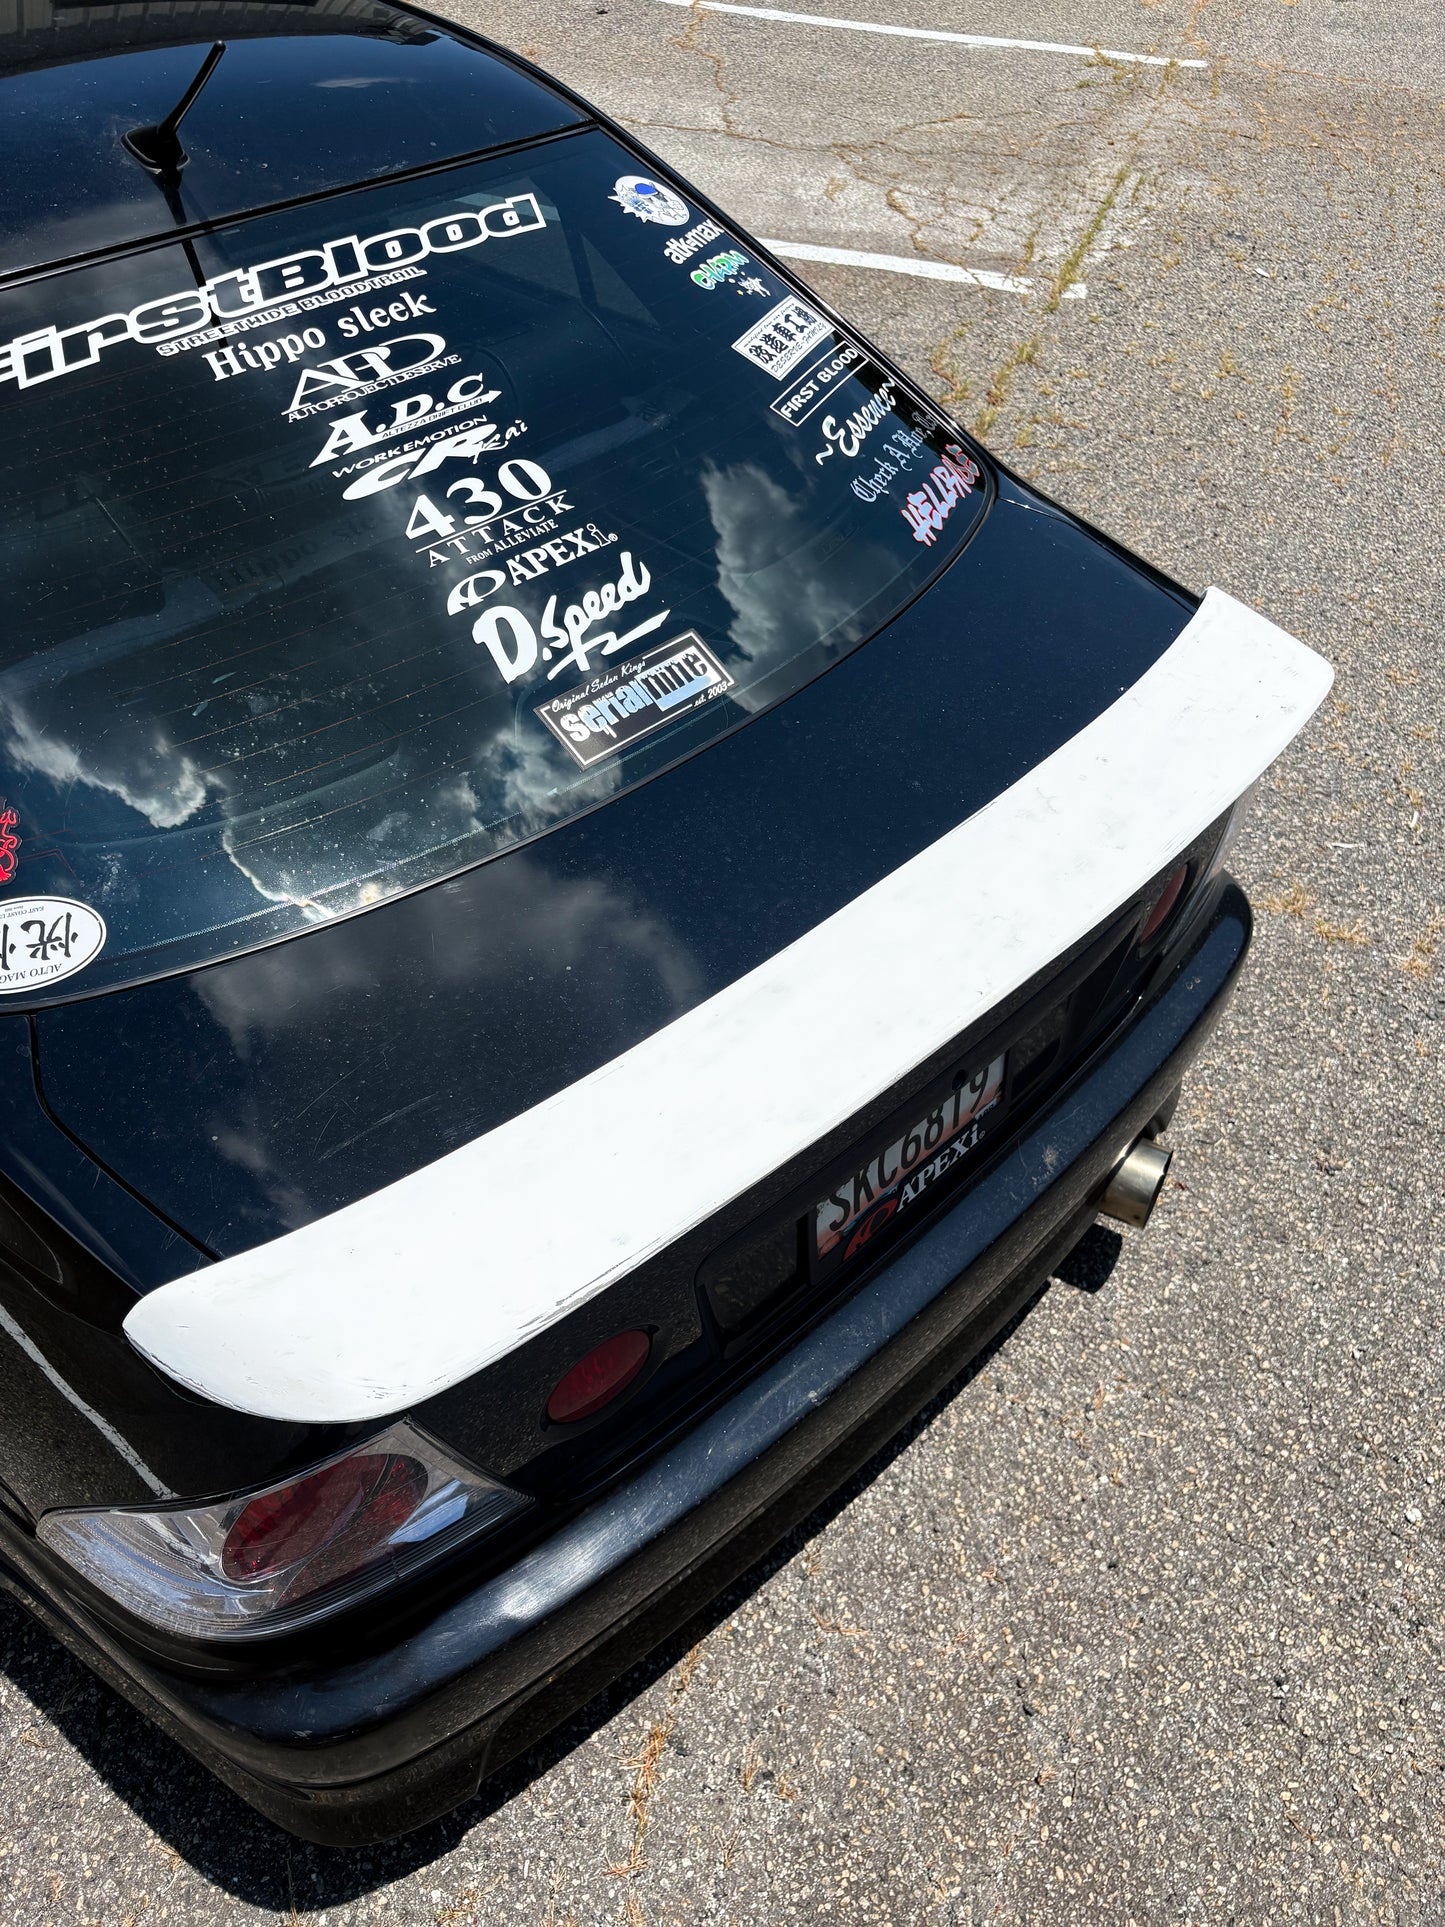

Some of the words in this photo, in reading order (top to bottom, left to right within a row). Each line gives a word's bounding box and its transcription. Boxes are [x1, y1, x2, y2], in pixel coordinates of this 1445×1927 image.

[156, 302, 301, 358] STREETWIDE
[297, 265, 427, 313] BLOODTRAIL
[201, 327, 327, 382] Hippo
[340, 292, 437, 340] sleek
[780, 379, 818, 420] FIRST
[817, 348, 859, 385] BLOOD
[308, 373, 485, 468] A.D.C
[331, 446, 405, 479] WORK
[402, 414, 489, 455] EMOTION
[381, 418, 428, 439] ALTEZZA
[427, 406, 457, 425] DRIFT
[405, 458, 553, 541] 430
[850, 457, 898, 503] Check
[883, 444, 913, 472] A
[428, 494, 576, 568] ATTACK
[465, 546, 493, 566] FROM
[493, 518, 559, 554] ALLEVIATE
[551, 688, 590, 714] Original
[590, 673, 620, 695] Sedan
[620, 657, 647, 681] Kings
[692, 693, 708, 709] est.
[707, 682, 729, 700] 2003
[29, 905, 45, 914] EAST
[29, 962, 63, 978] AUTO
